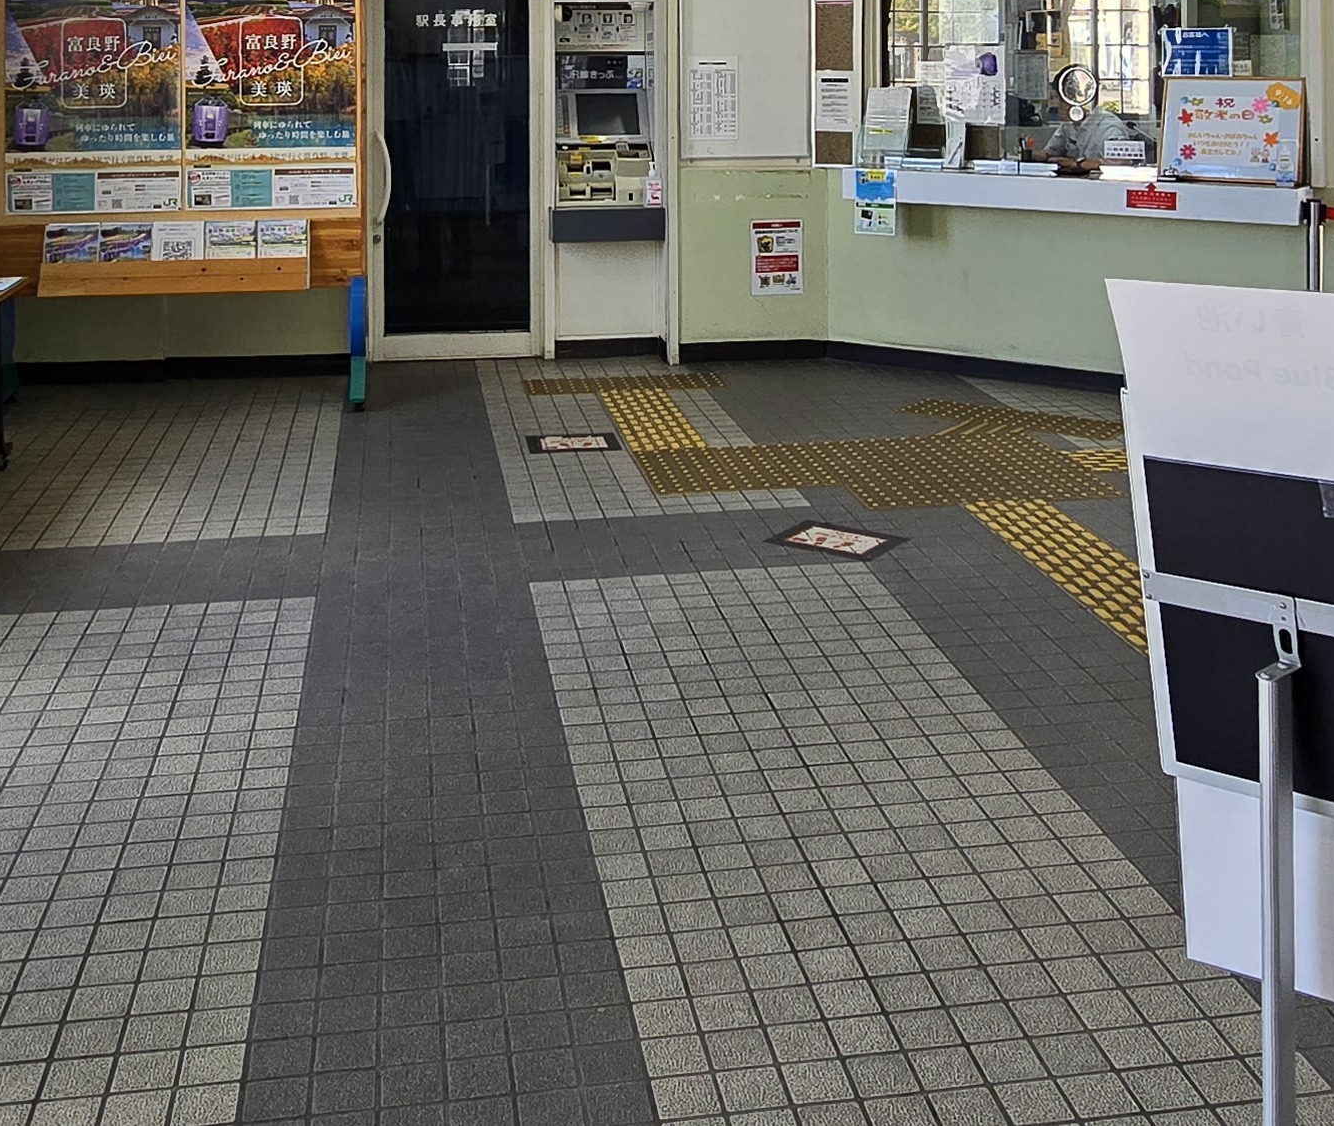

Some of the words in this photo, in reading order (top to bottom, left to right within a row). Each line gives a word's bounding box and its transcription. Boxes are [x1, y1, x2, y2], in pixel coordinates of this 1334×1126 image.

[67, 34, 121, 53] 富良野
[244, 33, 297, 51] 富良野
[72, 82, 117, 101] 美瑛
[249, 80, 293, 97] 美瑛
[1214, 97, 1236, 109] 祝
[1273, 88, 1294, 106] 9/16
[1193, 108, 1256, 121] 敬老の日
[74, 123, 137, 133] 列車にゆられて
[253, 120, 313, 130] 列車にゆられて
[163, 197, 179, 207] JR
[338, 194, 354, 203] JR
